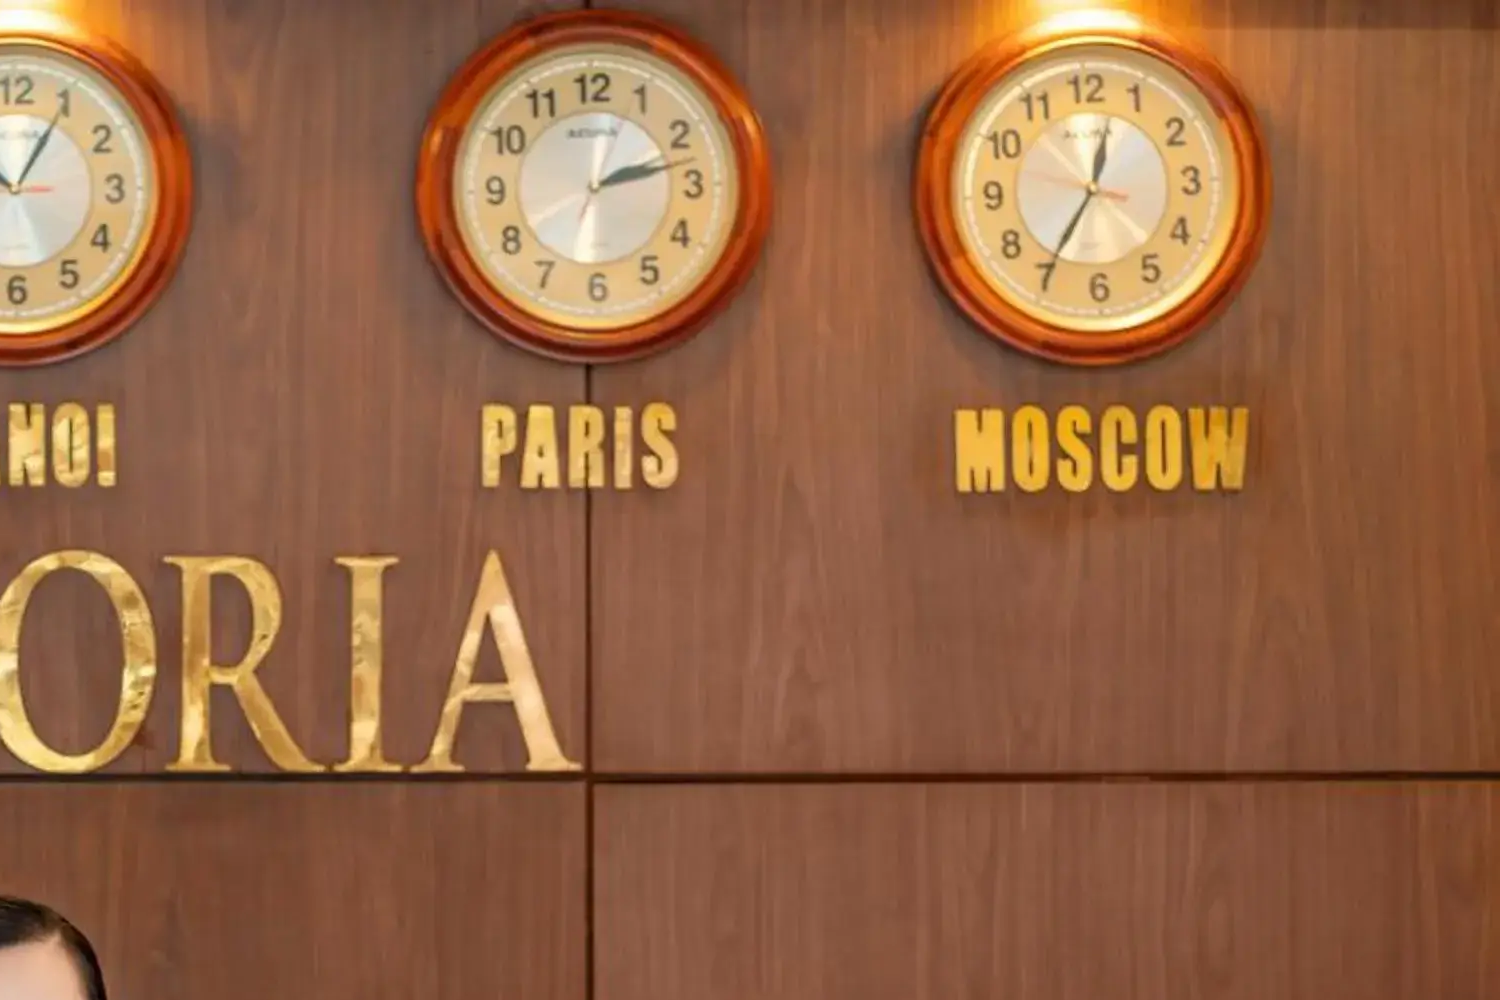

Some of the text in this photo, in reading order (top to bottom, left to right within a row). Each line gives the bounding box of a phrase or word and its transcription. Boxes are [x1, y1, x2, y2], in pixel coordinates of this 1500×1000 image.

[57, 89, 69, 116] 1
[574, 73, 610, 104] 12
[634, 86, 646, 114] 1
[1067, 74, 1104, 104] 12
[1127, 84, 1140, 112] 1
[526, 89, 555, 118] 11
[1020, 91, 1049, 120] 11
[92, 125, 112, 153] 2
[491, 125, 525, 155] 10
[670, 120, 690, 149] 2
[988, 129, 1021, 159] 10
[1165, 118, 1185, 146] 2
[105, 175, 125, 203] 3
[486, 176, 505, 205] 9
[683, 170, 703, 199] 3
[1181, 166, 1201, 195] 3
[983, 181, 1003, 210] 9
[91, 224, 110, 252] 4
[502, 226, 521, 254] 8
[670, 219, 690, 248] 4
[1002, 230, 1021, 258] 8
[1170, 217, 1190, 245] 4
[60, 260, 79, 288] 5
[534, 260, 555, 288] 7
[640, 256, 659, 284] 5
[1035, 262, 1055, 292] 7
[1141, 254, 1161, 283] 5
[7, 276, 27, 304] 6
[588, 273, 607, 301] 6
[1089, 273, 1109, 302] 6
[482, 403, 680, 490] PARIS
[954, 405, 1248, 493] MOSCOW
